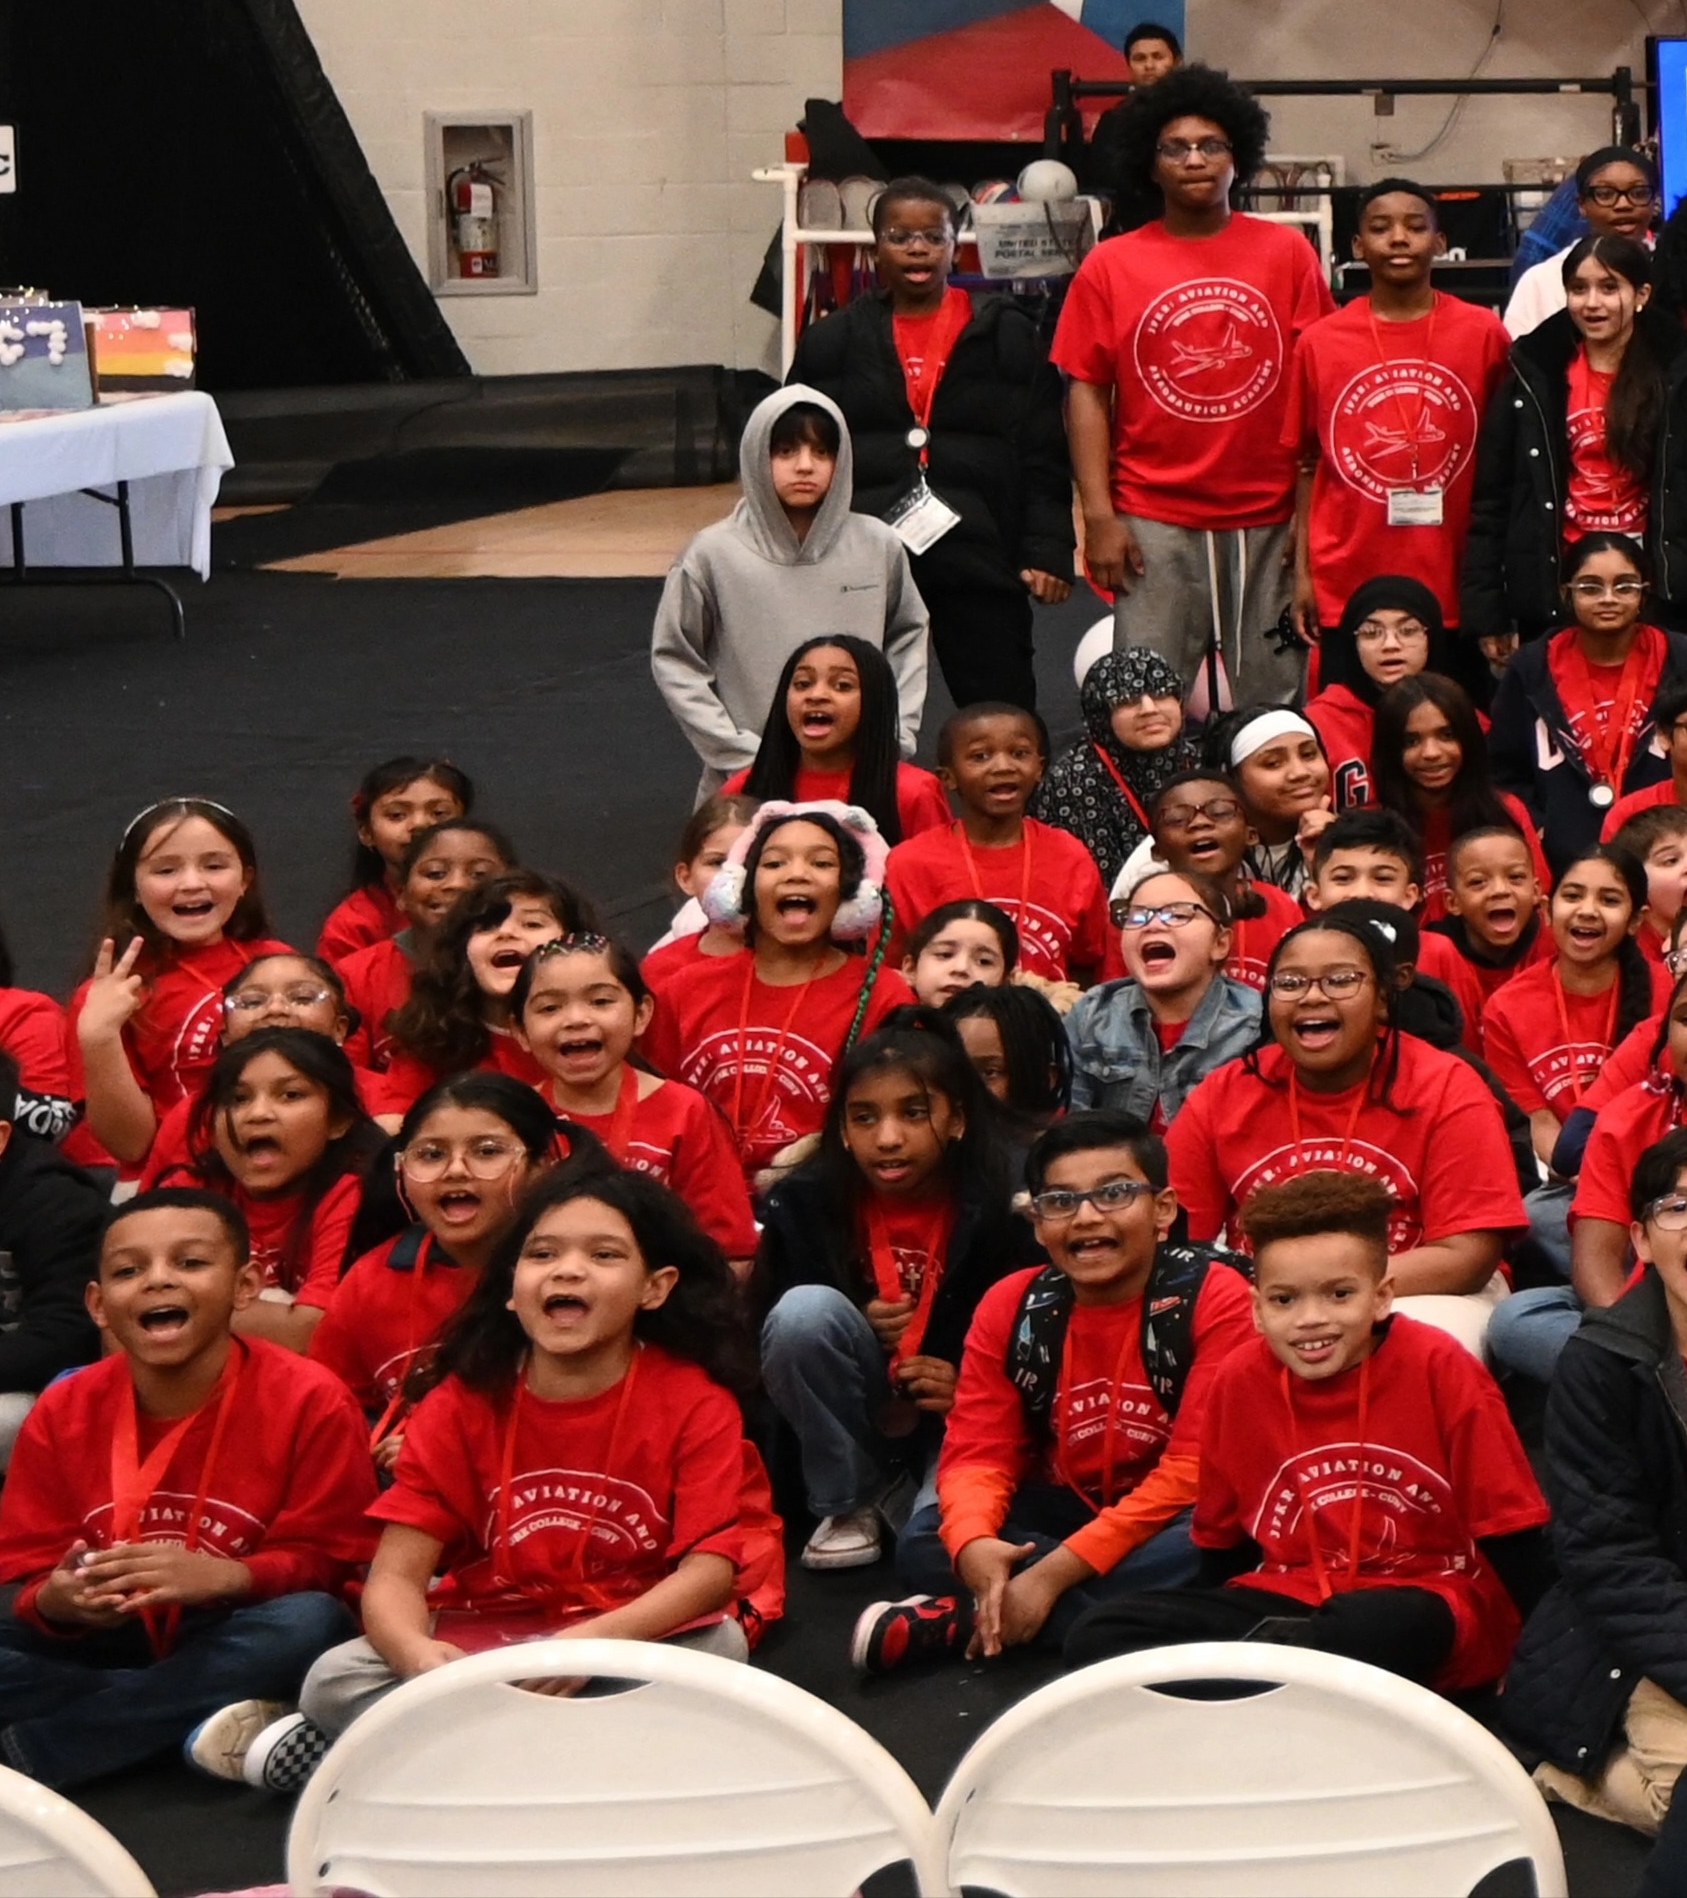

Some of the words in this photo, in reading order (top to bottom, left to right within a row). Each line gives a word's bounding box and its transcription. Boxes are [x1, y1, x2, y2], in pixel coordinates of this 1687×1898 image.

[1178, 286, 1248, 304] AVIATION
[1250, 303, 1269, 328] AND
[1149, 365, 1227, 415] AERONAUTICS
[1232, 359, 1274, 410] ACADEMY
[807, 1072, 831, 1104] AND
[1297, 1457, 1402, 1483] AVIATION
[513, 1487, 624, 1512] AVIATION
[626, 1512, 659, 1550] AND
